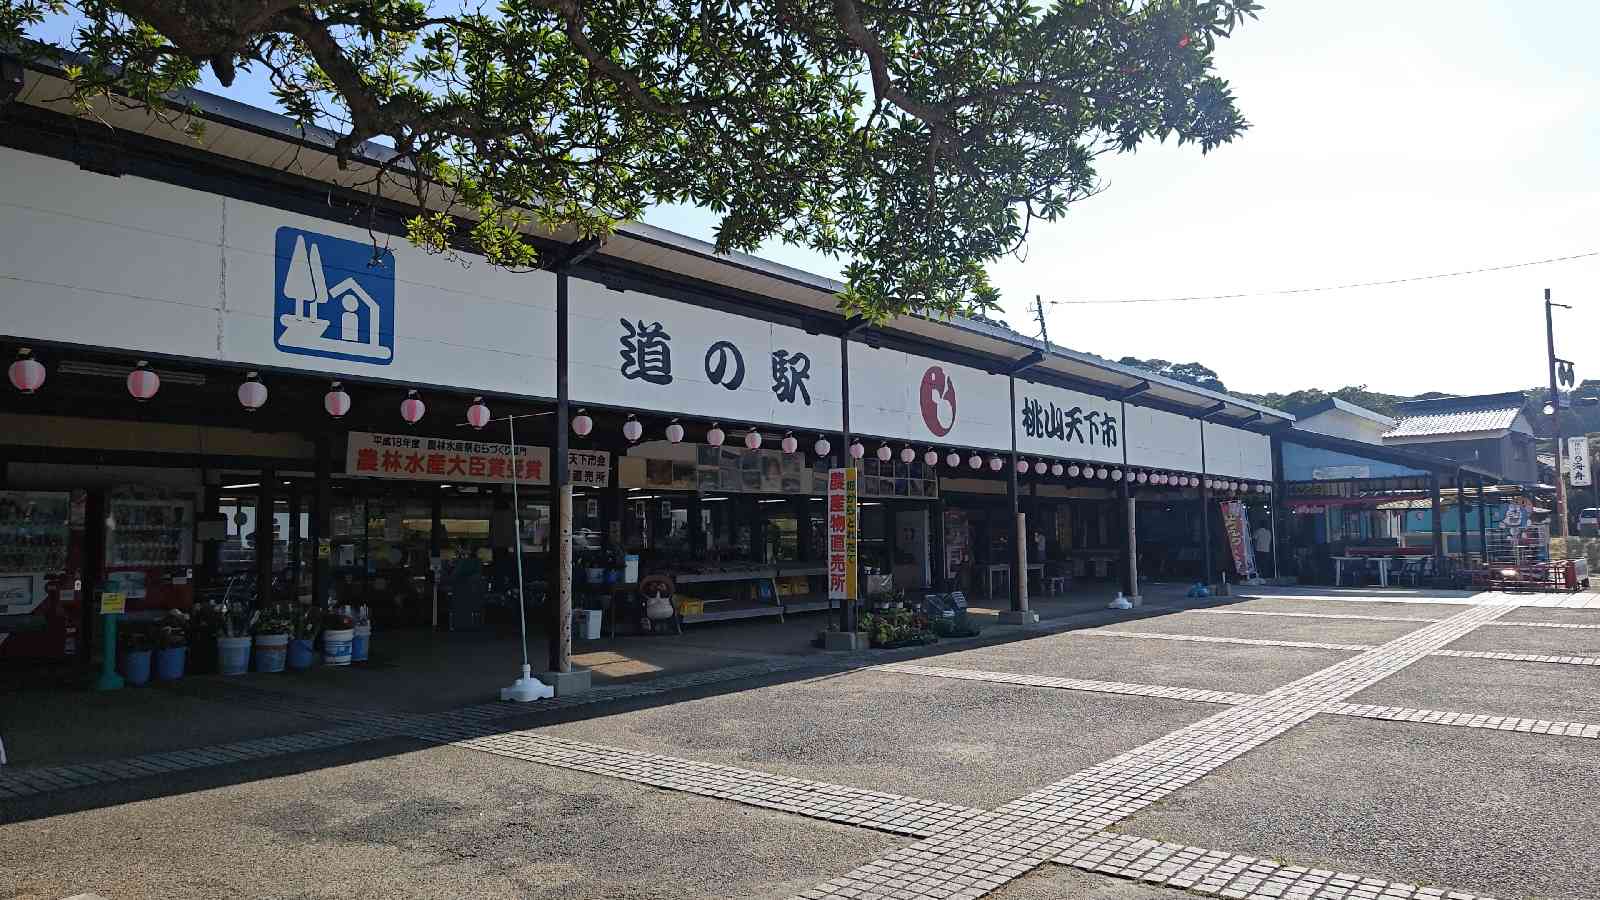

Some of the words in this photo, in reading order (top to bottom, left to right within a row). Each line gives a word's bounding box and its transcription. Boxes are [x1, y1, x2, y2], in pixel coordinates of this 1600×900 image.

[620, 318, 811, 406] 道の駅
[1022, 397, 1118, 448] 桃山天下市
[356, 448, 543, 480] 農林水産大臣賞受賞
[830, 471, 846, 592] 農産物直売所
